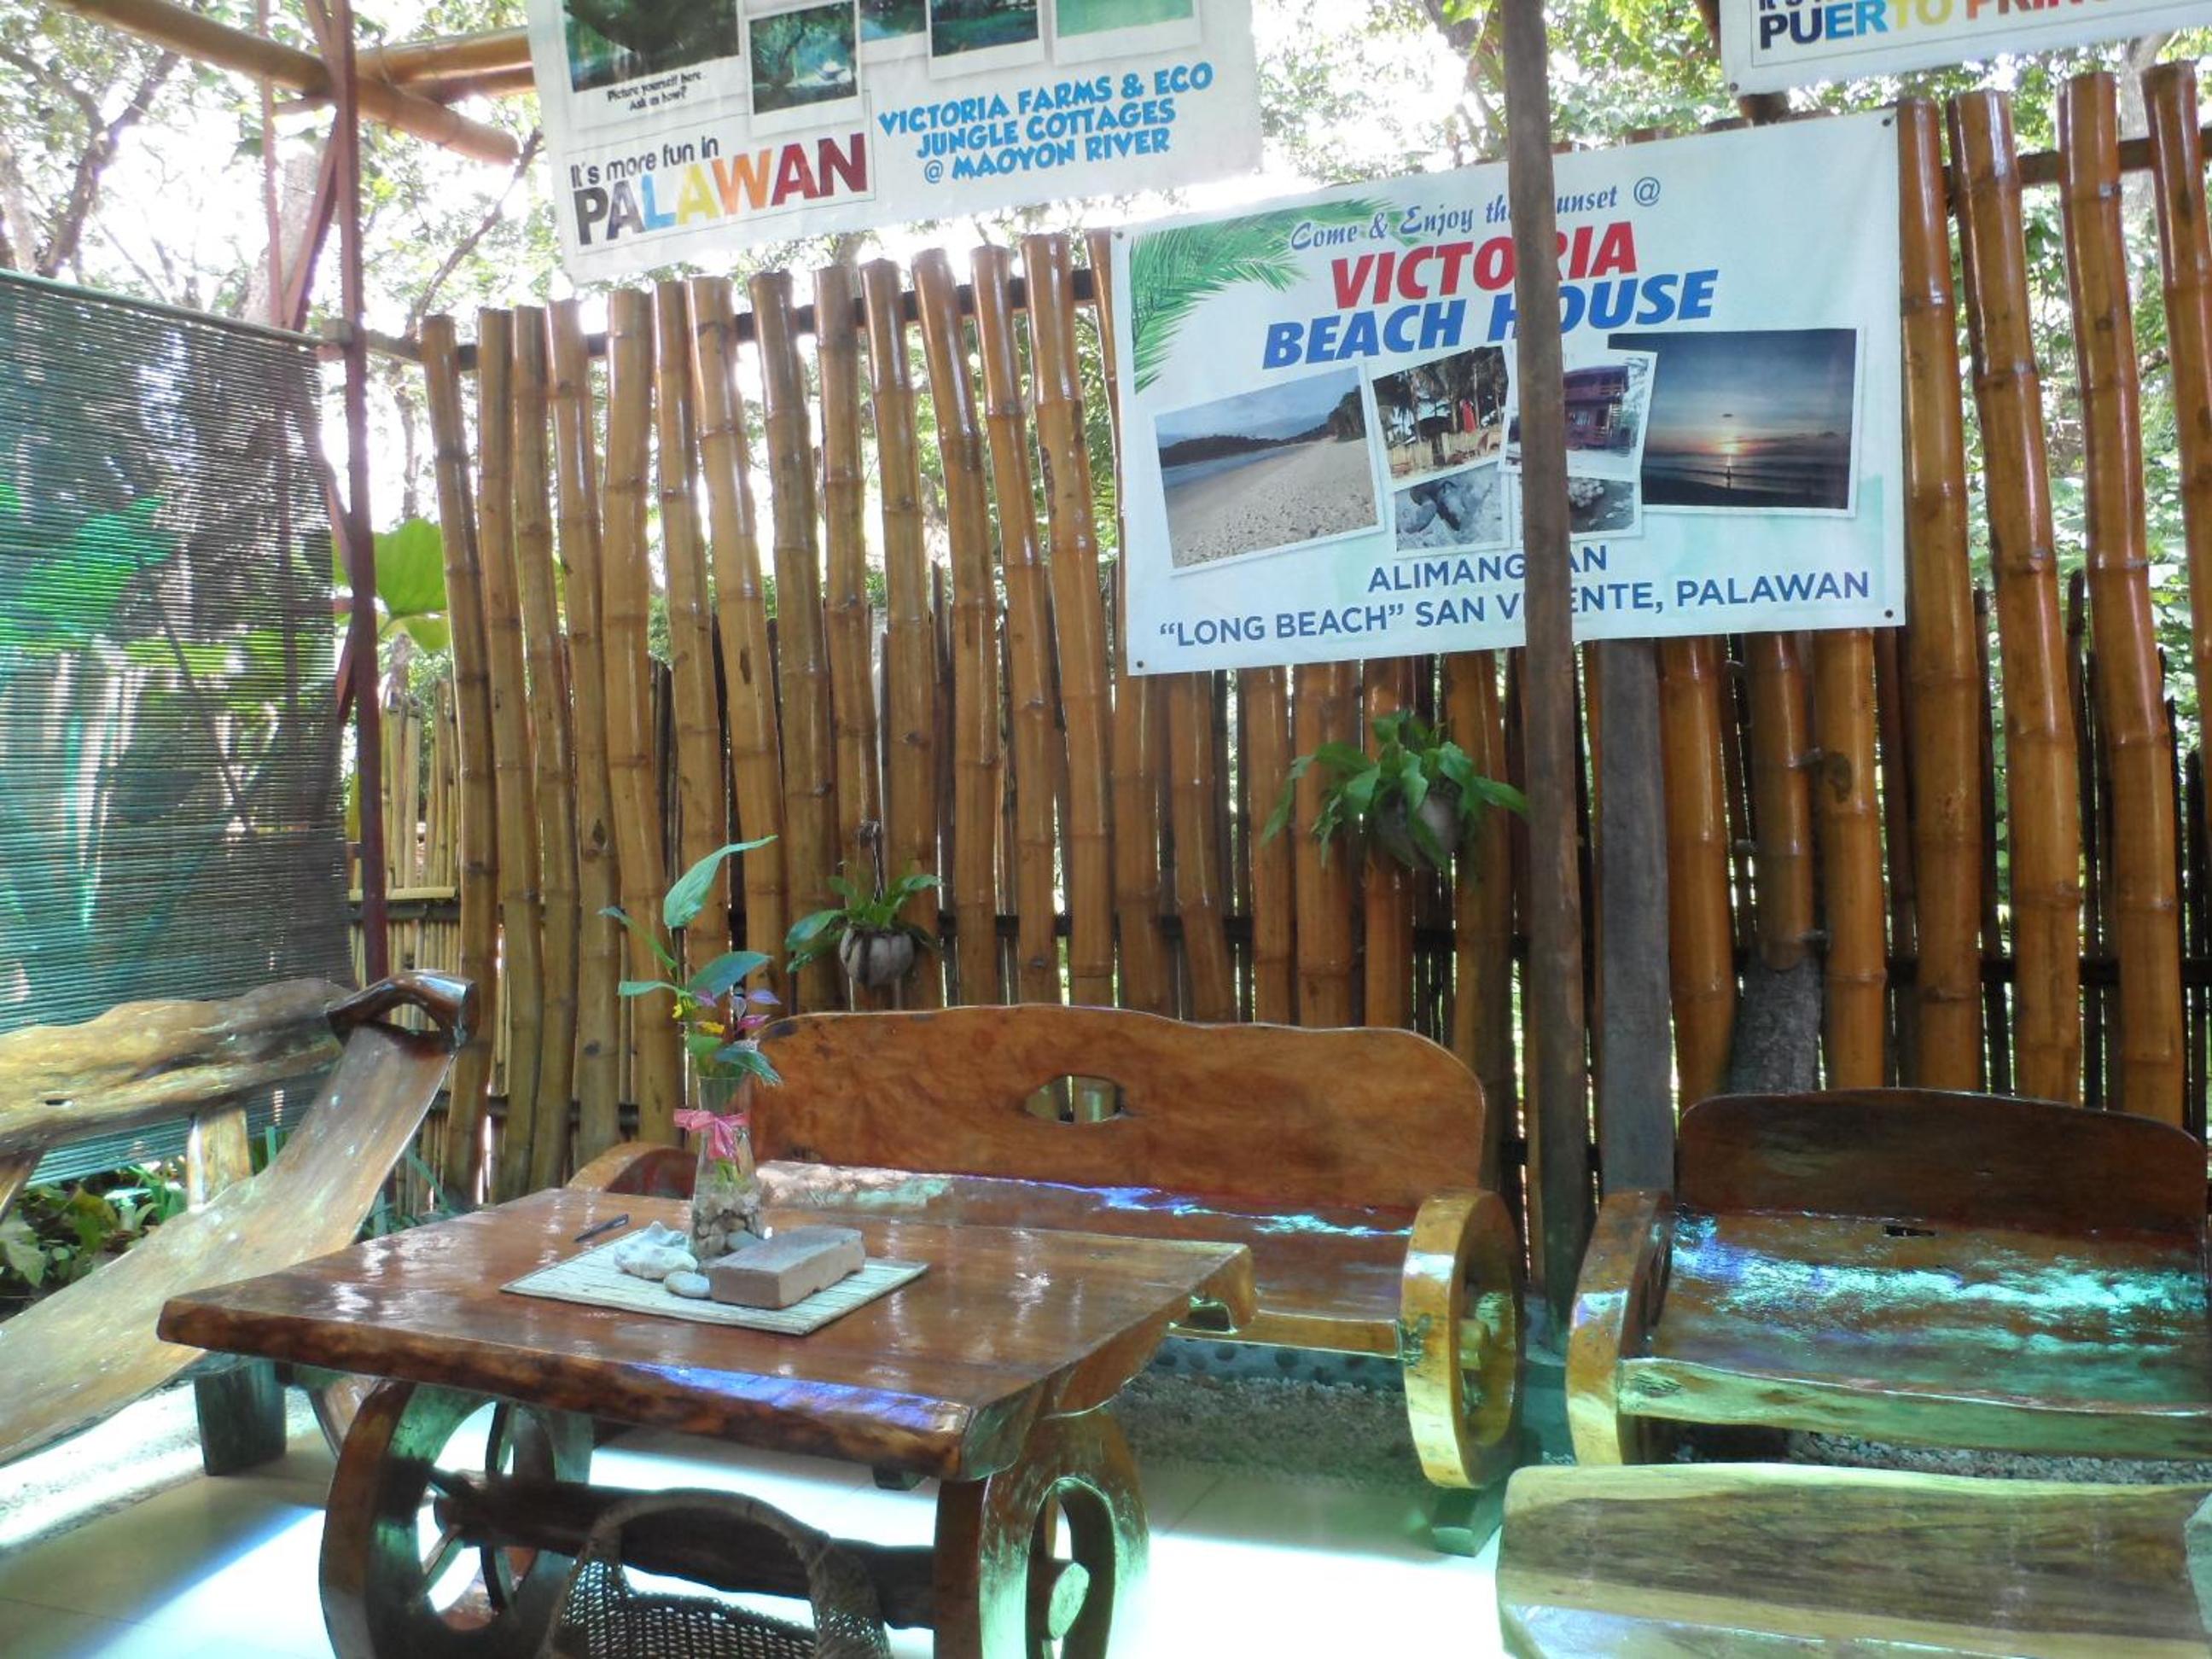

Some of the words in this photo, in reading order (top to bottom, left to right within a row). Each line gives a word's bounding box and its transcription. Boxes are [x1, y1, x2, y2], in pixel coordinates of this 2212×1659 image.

[1760, 0, 1953, 49] PUERTO
[878, 95, 1010, 137] VICTORIA
[1018, 76, 1112, 115] FARMS
[1121, 73, 1144, 98] &
[1155, 62, 1214, 95] ECO
[917, 119, 1017, 159] JUNGLE
[1027, 98, 1176, 140] COTTAGES
[571, 162, 600, 189] It's
[607, 152, 656, 181] more
[663, 143, 695, 167] fun
[701, 136, 719, 159] in
[924, 160, 943, 183] @
[952, 138, 1076, 180] MAOYON
[1086, 128, 1170, 161] RIVER
[573, 133, 867, 245] PALAWAN
[1291, 223, 1357, 250] Come
[1370, 212, 1388, 239] &
[1400, 205, 1474, 236] Enjoy
[1486, 194, 1511, 224] th
[1557, 185, 1617, 214] unset
[1634, 177, 1661, 207] @
[1263, 299, 1467, 370] BEACH
[1416, 596, 1484, 627] SAN
[1677, 572, 1869, 607] PALAWAN
